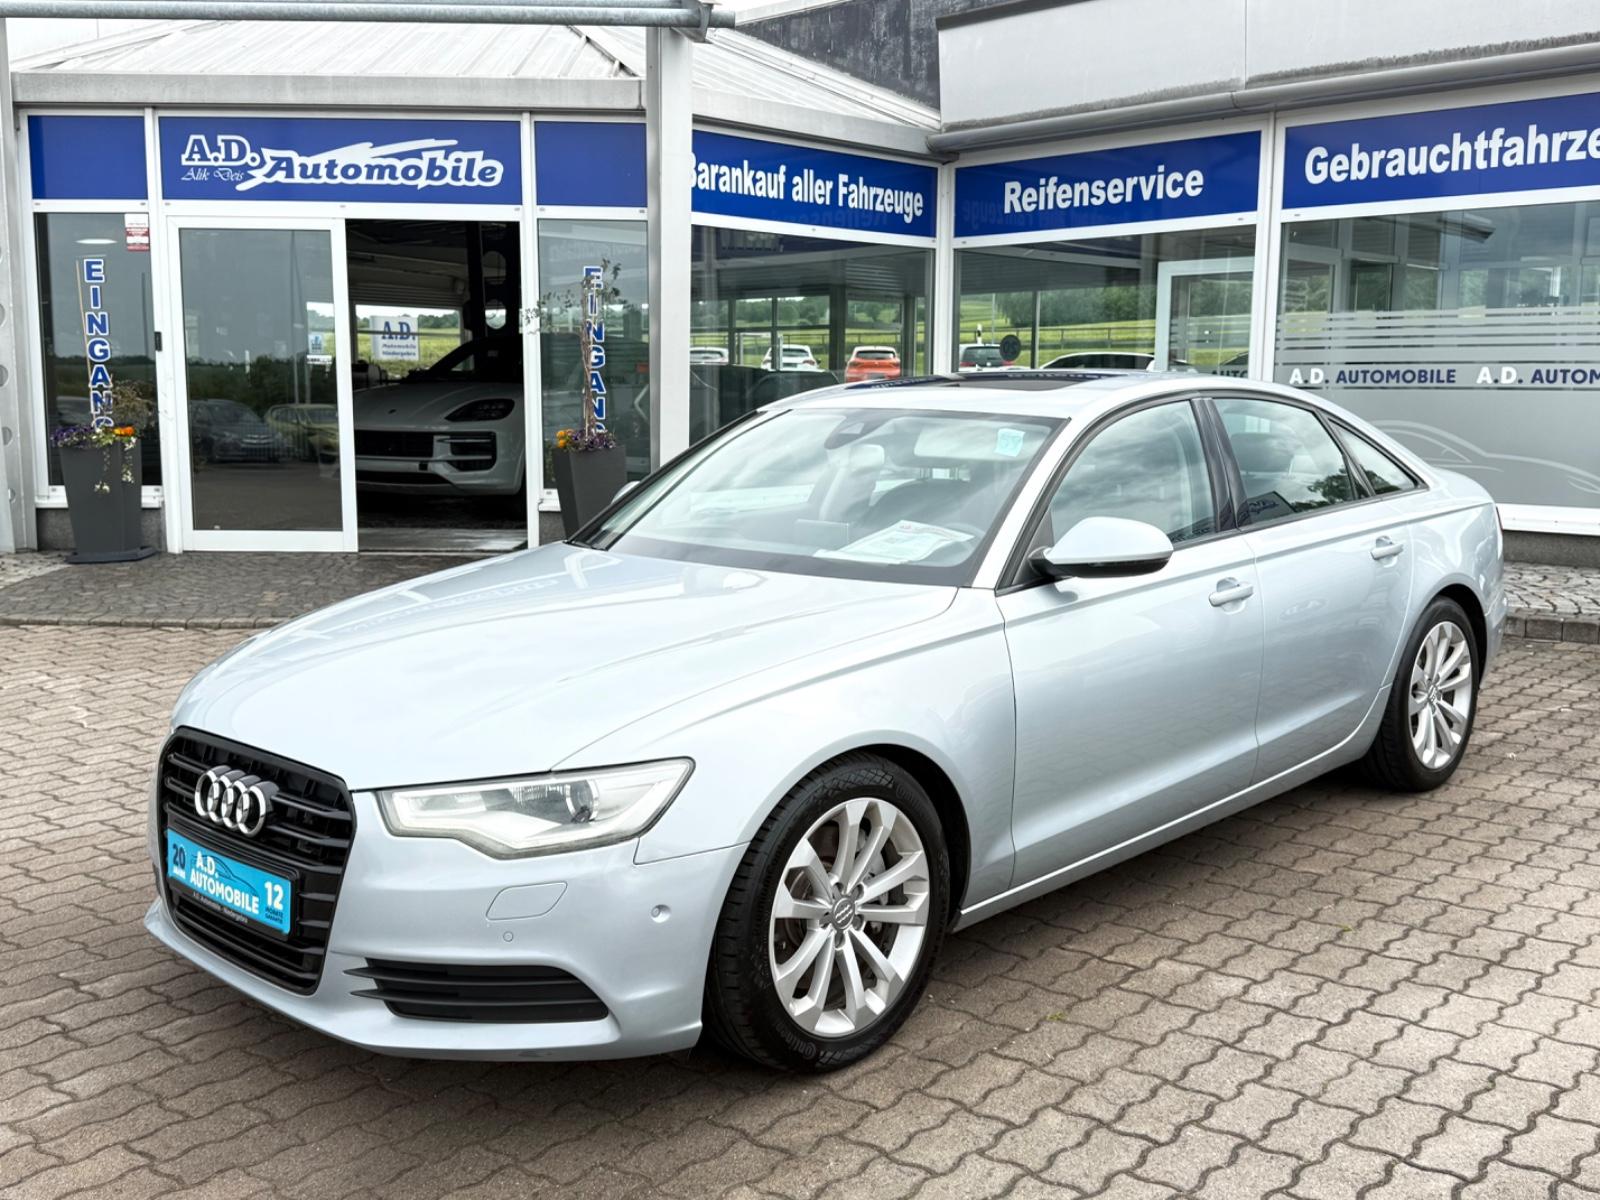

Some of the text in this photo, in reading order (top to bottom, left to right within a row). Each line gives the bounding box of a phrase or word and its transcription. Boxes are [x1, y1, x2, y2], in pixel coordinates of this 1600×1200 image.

[181, 167, 245, 181] Alik Deis
[182, 135, 504, 189] A.D. Automobile
[691, 151, 786, 200] arankauf
[792, 169, 833, 205] aller
[838, 173, 924, 224] Fahrzeuge
[1004, 165, 1204, 214] Reifenservice
[381, 320, 416, 341] A.D.
[1289, 368, 1457, 384] A.D. AUTOMOBILE
[1476, 366, 1524, 384] A.D.
[172, 843, 186, 870] 20
[195, 851, 219, 878] A.D.
[190, 868, 260, 915] AUTOMOBILE
[264, 881, 284, 911] 12
